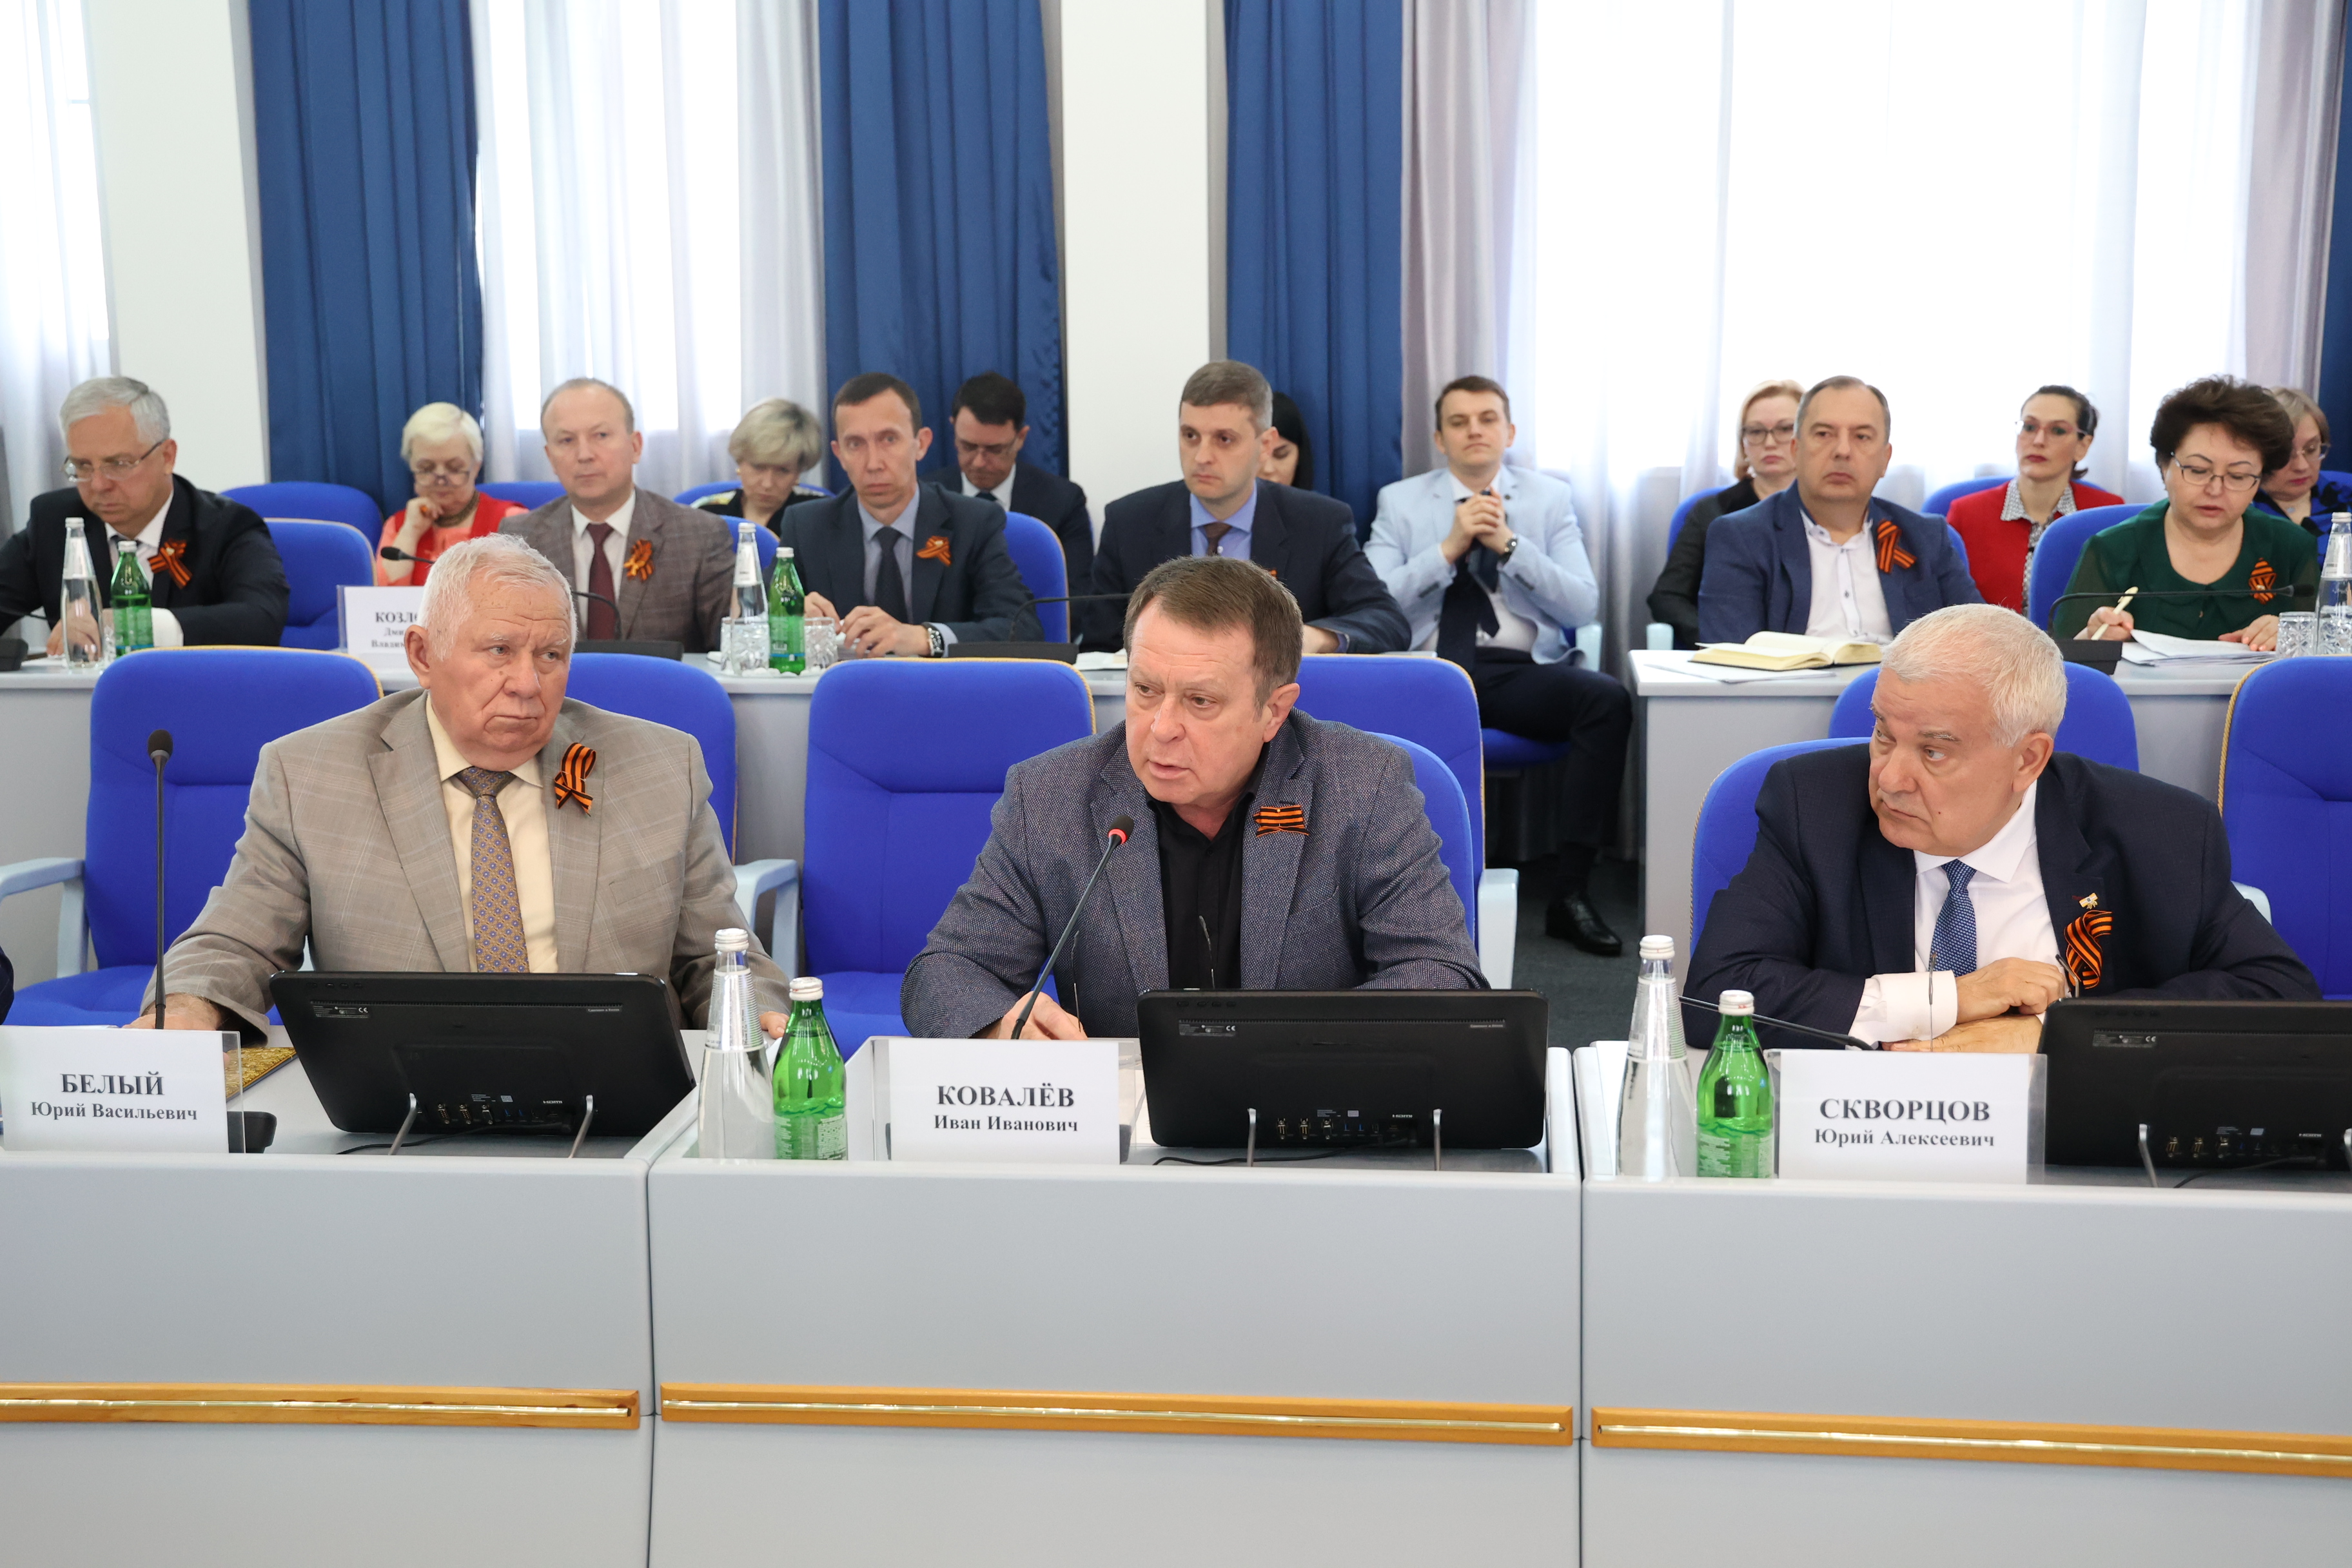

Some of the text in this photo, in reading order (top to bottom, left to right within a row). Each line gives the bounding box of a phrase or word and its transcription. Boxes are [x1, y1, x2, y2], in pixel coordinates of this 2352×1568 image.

[61, 1070, 165, 1096] БЕЛЫЙ
[937, 1083, 1075, 1107] КОВАЛЁВ
[31, 1101, 198, 1121] Юрий Васильевич
[1819, 1099, 1990, 1124] СКВОРЦОВ
[934, 1115, 1078, 1132] Иван Иванович
[1815, 1128, 1994, 1148] Юрий Алексеевич
